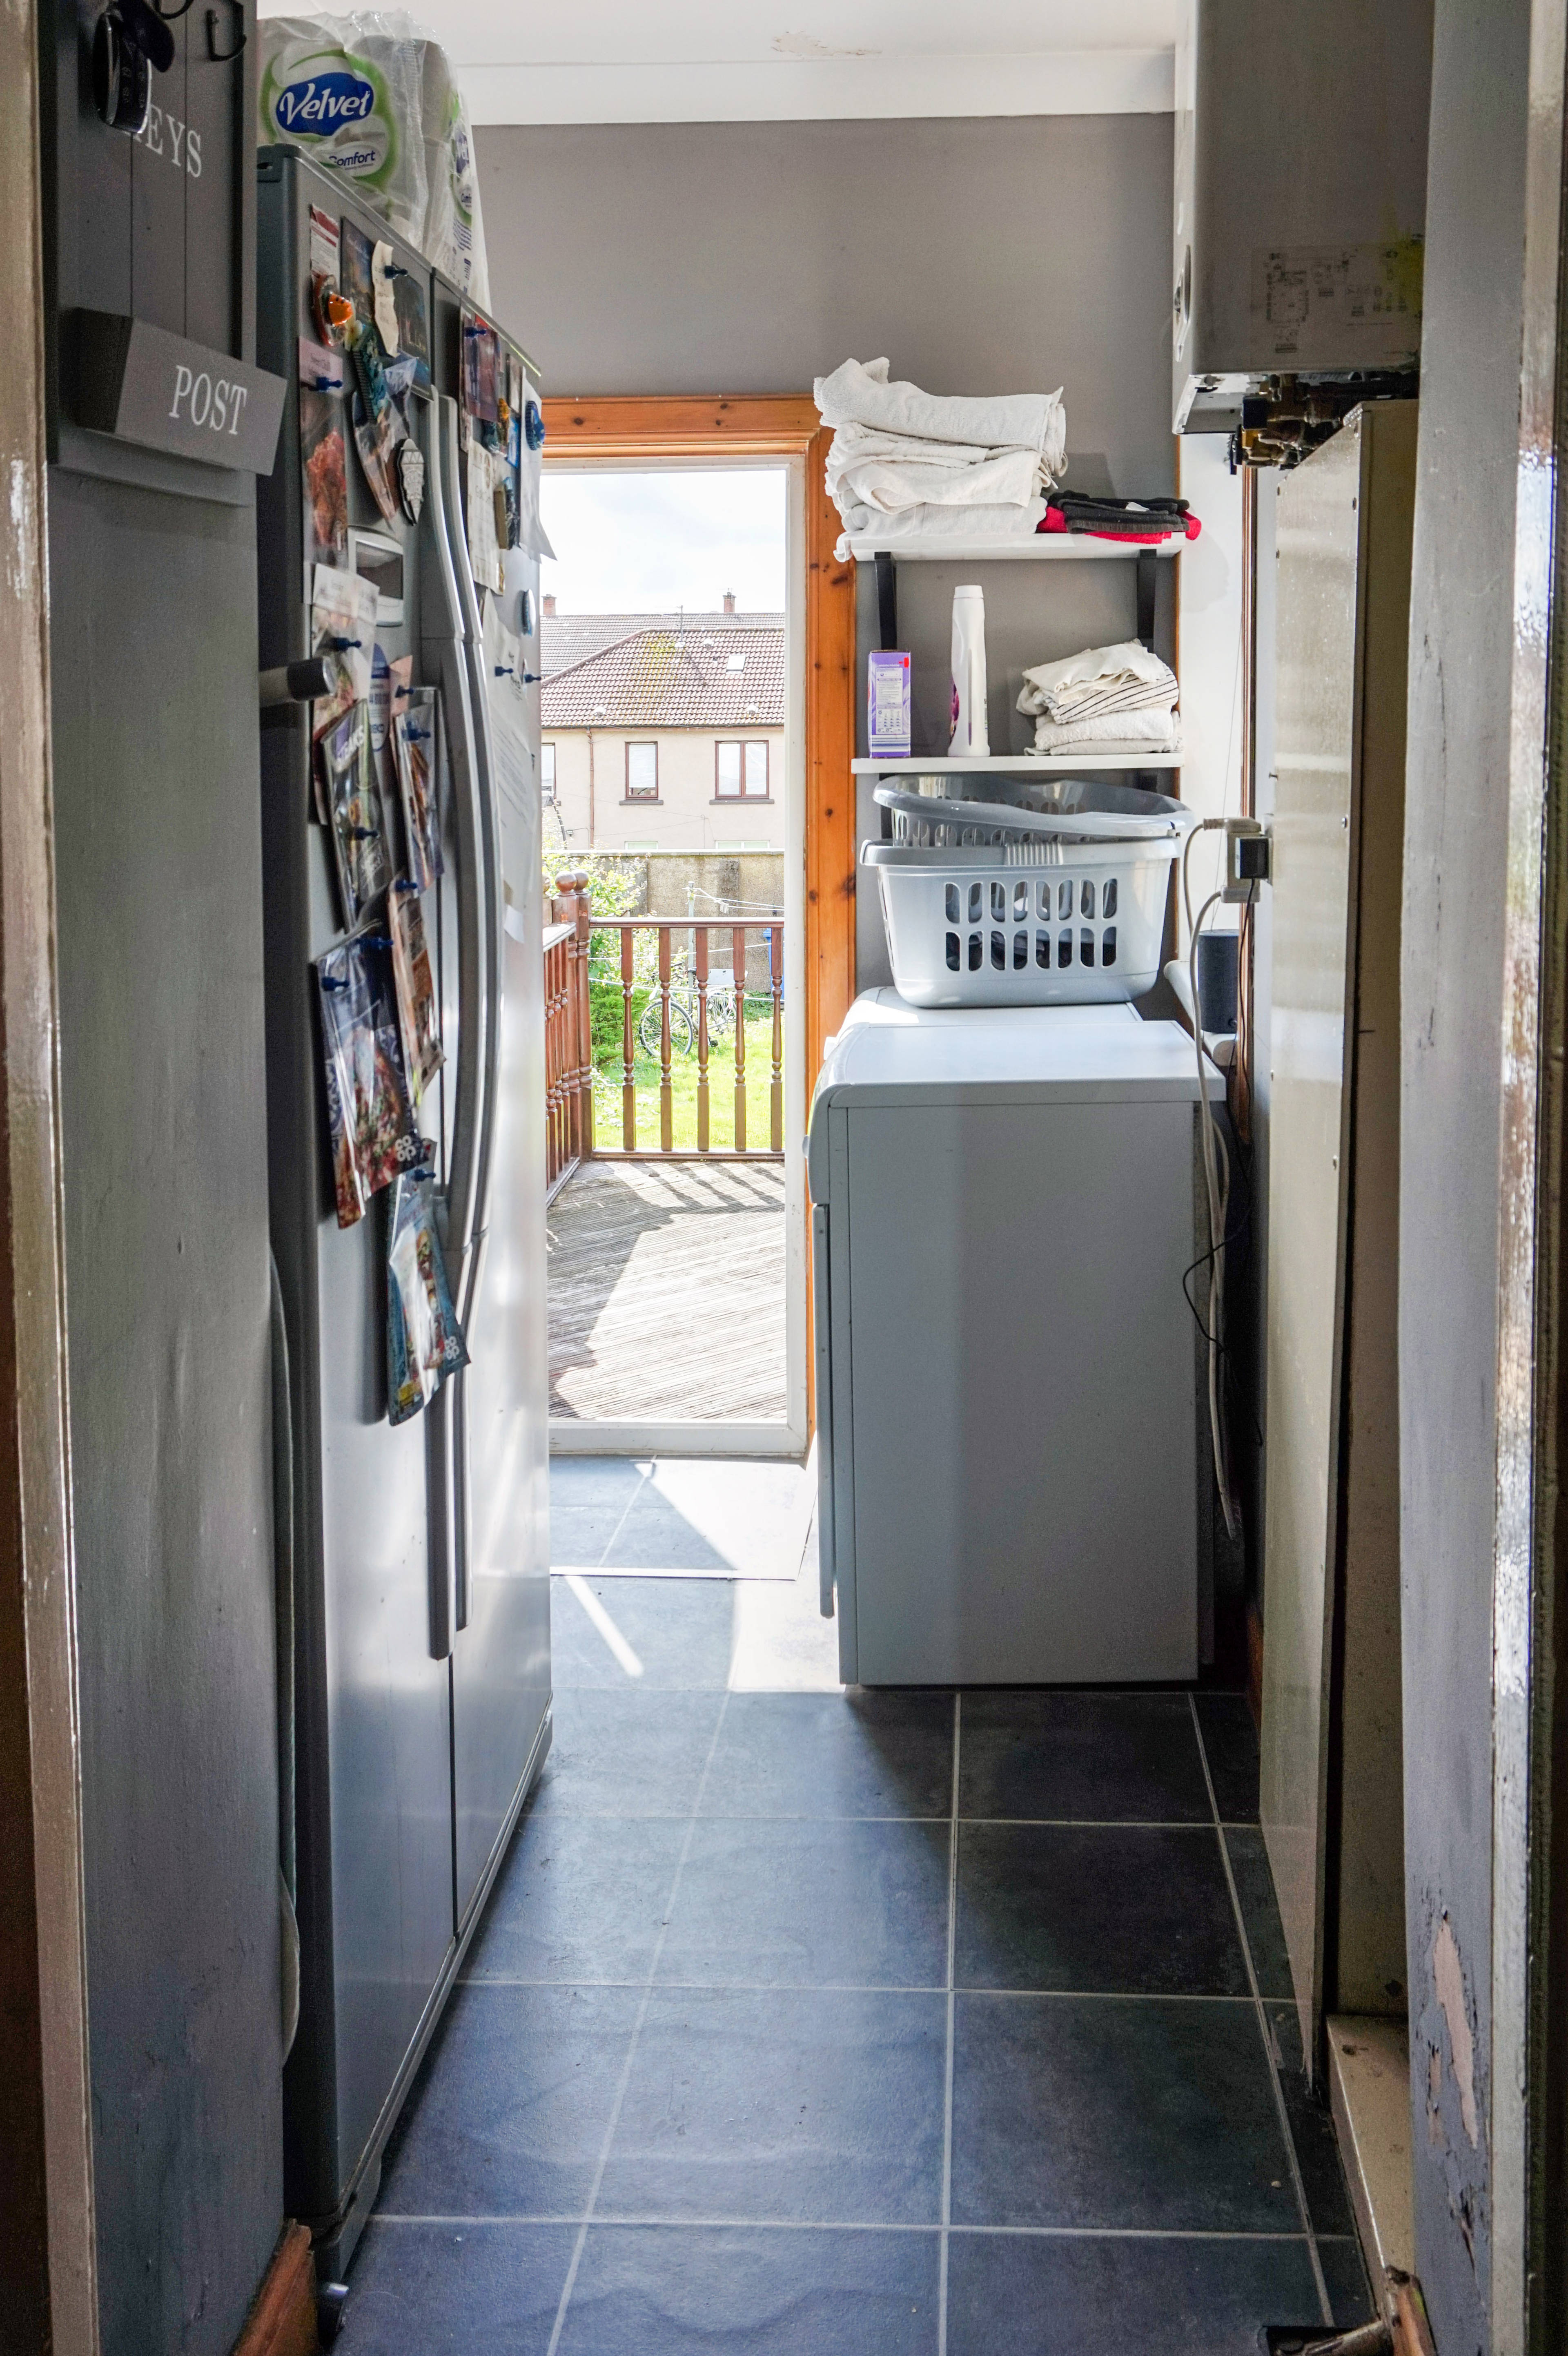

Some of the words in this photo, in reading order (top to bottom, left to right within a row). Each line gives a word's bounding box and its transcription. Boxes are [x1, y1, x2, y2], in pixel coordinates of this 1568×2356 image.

[279, 83, 371, 125] Velvet
[124, 104, 202, 178] EYS
[169, 365, 247, 435] POST
